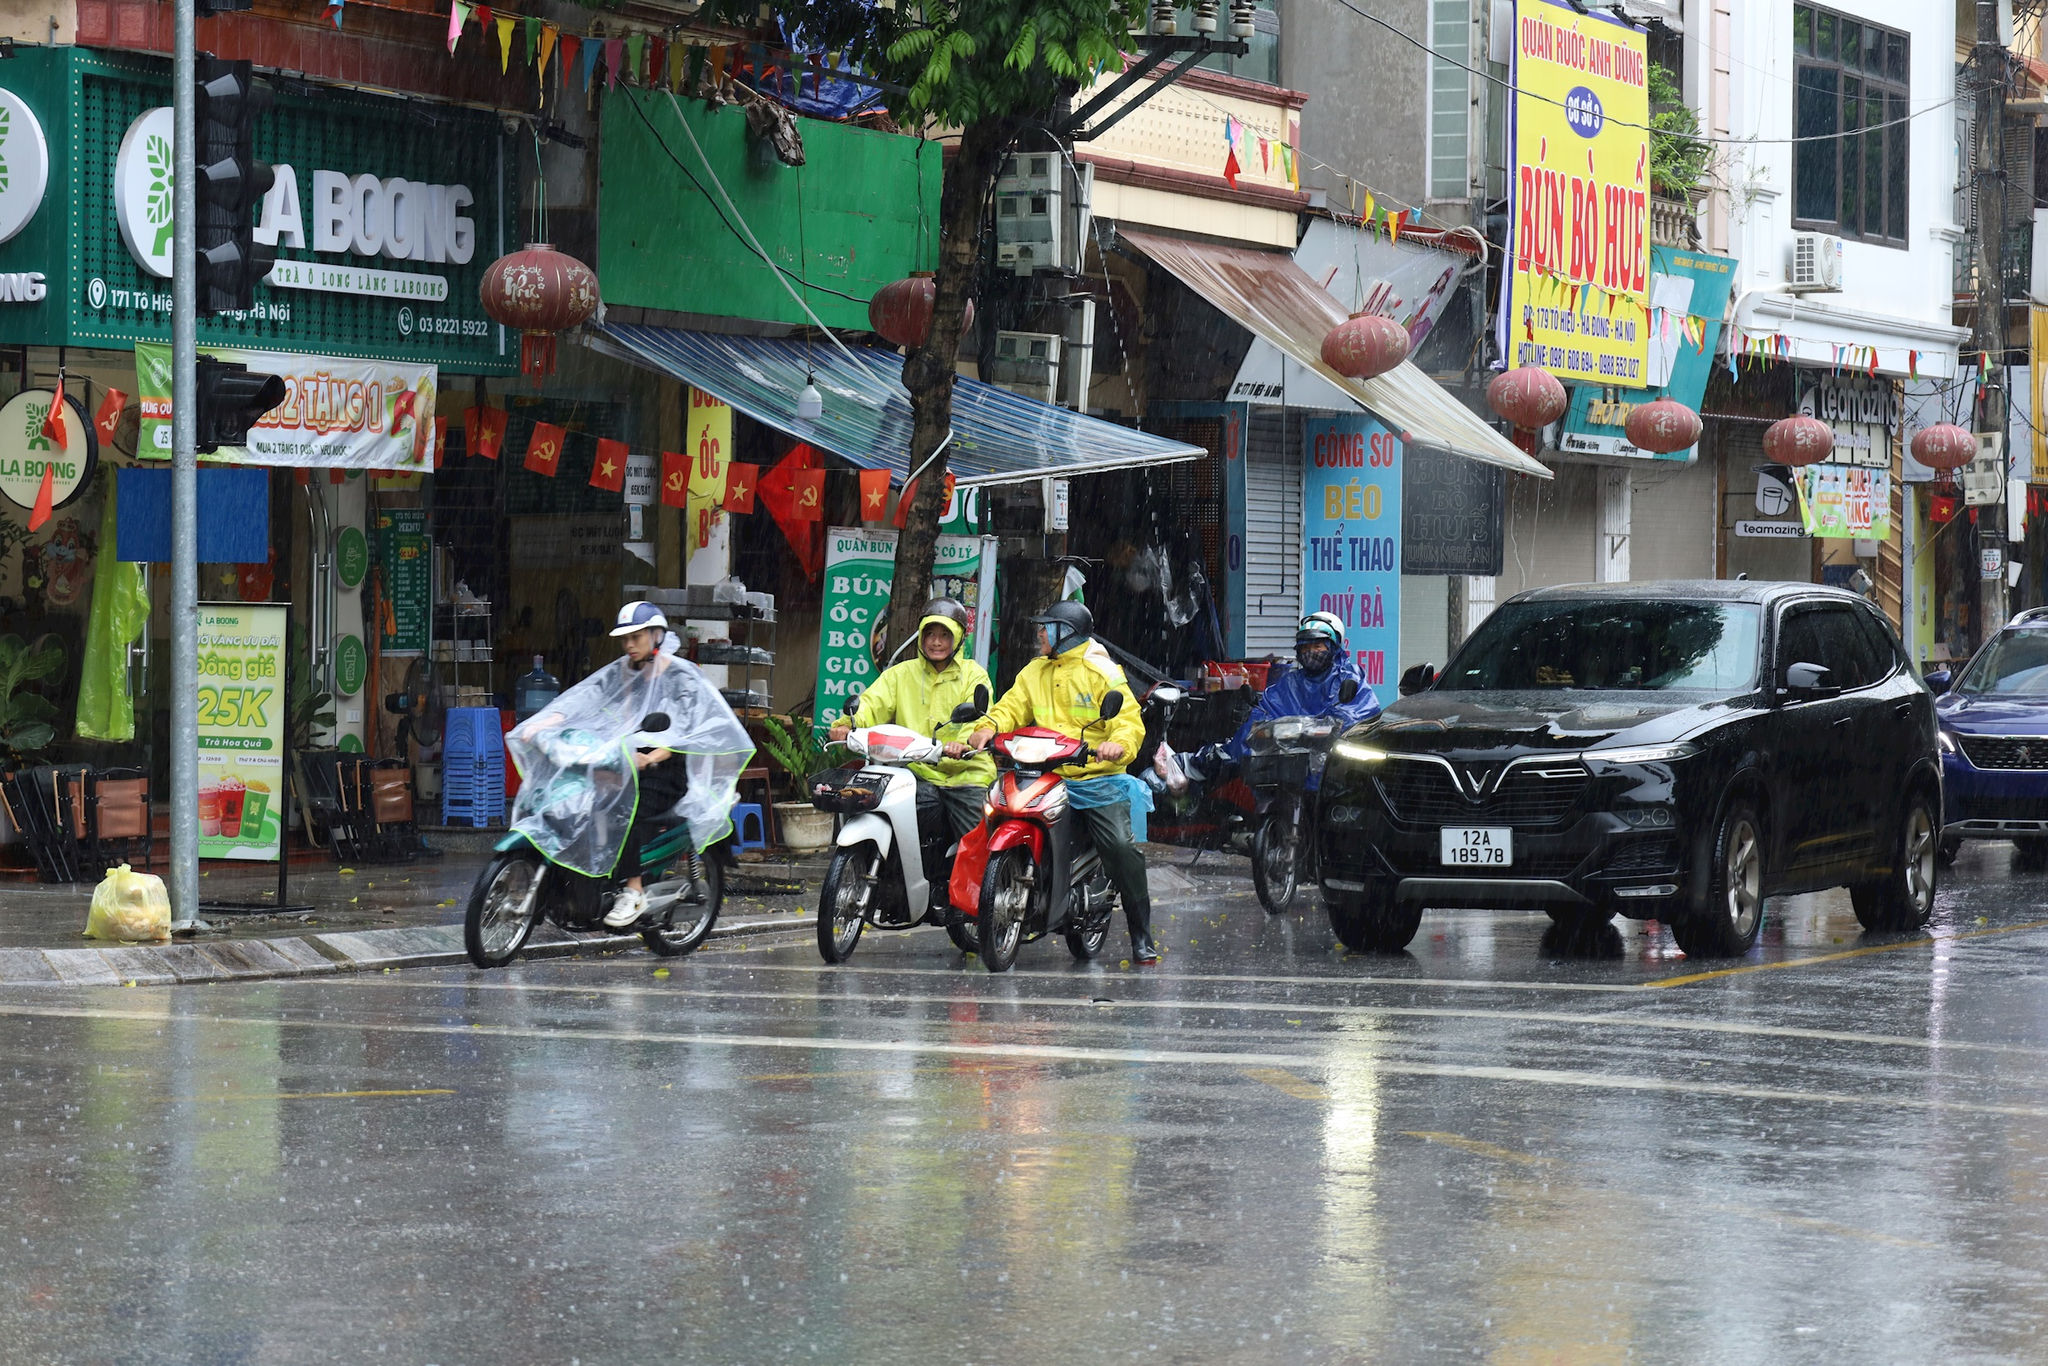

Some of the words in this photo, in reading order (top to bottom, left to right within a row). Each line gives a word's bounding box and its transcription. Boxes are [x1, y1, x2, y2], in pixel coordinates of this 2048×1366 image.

[1522, 14, 1553, 61] QUÁN
[1556, 20, 1585, 71] RUỐC
[1589, 38, 1611, 78] ANH
[1614, 41, 1644, 87] DŨNG
[1568, 95, 1580, 124] CƠ
[1593, 103, 1600, 129] 3
[252, 164, 306, 249] A
[313, 169, 476, 265] BOONG
[1518, 136, 1566, 278] BÚN
[1570, 149, 1599, 282] BÒ
[1603, 142, 1646, 293] HUẾ
[0, 271, 47, 302] NG
[277, 266, 300, 284] TRÀ
[307, 267, 314, 285] Ô
[321, 272, 350, 289] LONG
[358, 272, 387, 292] LÀNG
[394, 279, 444, 298] LABOONG
[111, 289, 130, 308] 171
[133, 291, 149, 310] Tô
[152, 294, 173, 317] Hiệ
[250, 302, 266, 319] Hà
[269, 303, 290, 325] Nội
[419, 316, 433, 333] 03
[436, 318, 460, 335] 8221
[462, 320, 488, 337] 5922
[1537, 307, 1549, 329] 179
[1581, 310, 1590, 335] HÀ
[1592, 312, 1610, 339] ĐÔNG
[1615, 316, 1624, 341] HÀ
[1625, 317, 1636, 347] NỘI
[1518, 342, 1548, 367] HOTLINE:
[1550, 346, 1566, 369] 0981
[1568, 349, 1580, 371] 608
[1616, 356, 1627, 378] 552
[282, 377, 299, 428] 2
[303, 370, 365, 432] TẶNG
[367, 381, 383, 429] 1
[1821, 378, 1900, 437] teamazing
[699, 424, 720, 479] ỐC
[1314, 426, 1364, 468] CÔNG
[0, 459, 21, 476] LA
[1324, 478, 1382, 520] BÉO
[1743, 523, 1805, 537] teamazing
[942, 544, 957, 558] CÔ
[959, 546, 972, 559] LÝ
[1310, 523, 1343, 572] THỂ
[1348, 536, 1394, 572] THAO
[831, 573, 893, 596] BÚN
[205, 616, 214, 625] LA
[216, 616, 239, 625] BOONG
[829, 599, 868, 624] ỐC
[1360, 586, 1385, 628] BÀ
[212, 633, 241, 647] VÀNG
[828, 628, 866, 650] BÒ
[246, 654, 276, 681] giá
[825, 654, 870, 675] GIÒ
[197, 686, 273, 728] 25K
[205, 738, 220, 747] Trà
[222, 738, 241, 747] Hoa
[243, 738, 262, 748] Quả
[1463, 830, 1491, 846] 12A
[1451, 848, 1504, 863] 189.78
